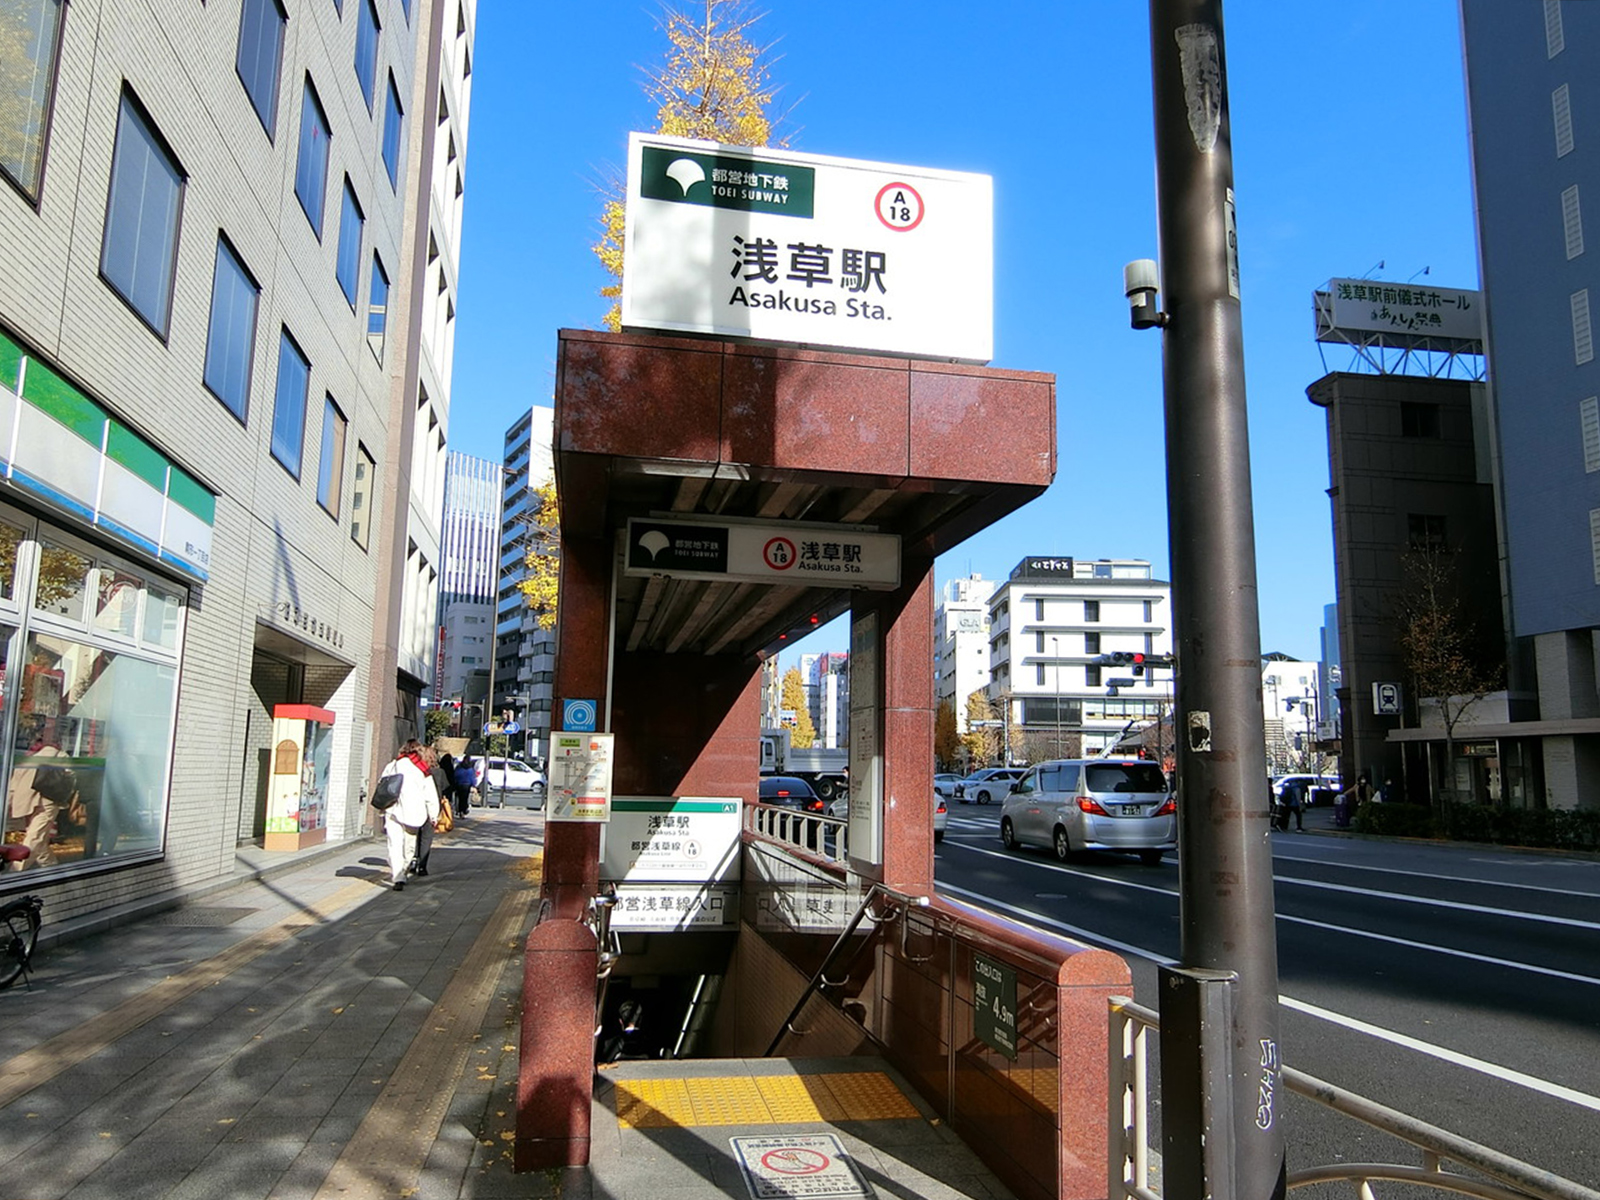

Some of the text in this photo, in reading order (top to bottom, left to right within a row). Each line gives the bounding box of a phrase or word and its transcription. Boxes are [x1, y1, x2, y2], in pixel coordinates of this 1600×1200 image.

[712, 168, 789, 192] 都営地下鉄
[711, 185, 789, 205] TOEI SUBWAY
[893, 191, 906, 205] A
[889, 205, 911, 222] 18
[730, 235, 887, 295] 浅草駅
[729, 286, 893, 321] Asakusa Sta.
[1337, 283, 1470, 310] 浅草駅前儀式ホール
[775, 542, 785, 552] A
[801, 541, 861, 563] 浅草駅
[772, 552, 788, 563] 18
[798, 561, 863, 573] Asakusa Sta.
[648, 815, 690, 829] 浅草駅
